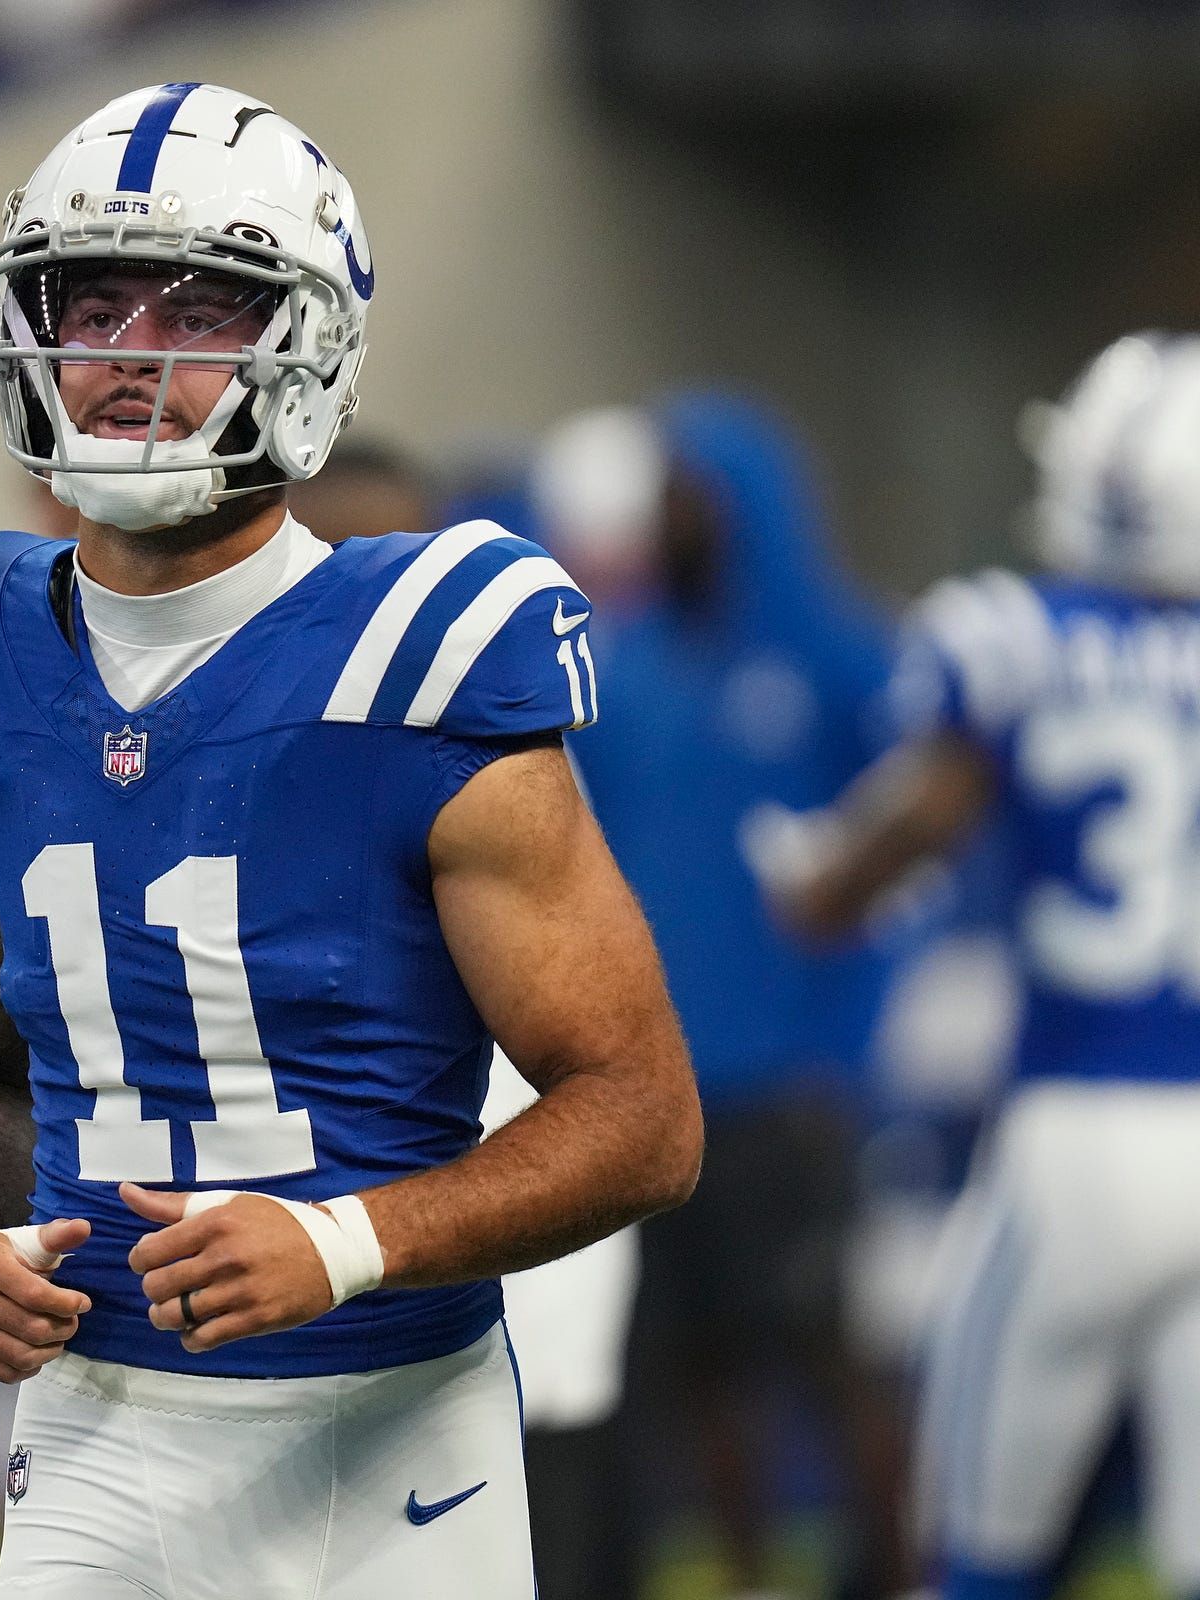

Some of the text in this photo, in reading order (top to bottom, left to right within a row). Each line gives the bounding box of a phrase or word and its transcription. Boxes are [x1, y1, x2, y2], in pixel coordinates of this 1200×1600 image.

[104, 200, 150, 215] COLTS
[556, 632, 598, 727] 11
[110, 753, 139, 775] NFL
[21, 842, 317, 1183] 11
